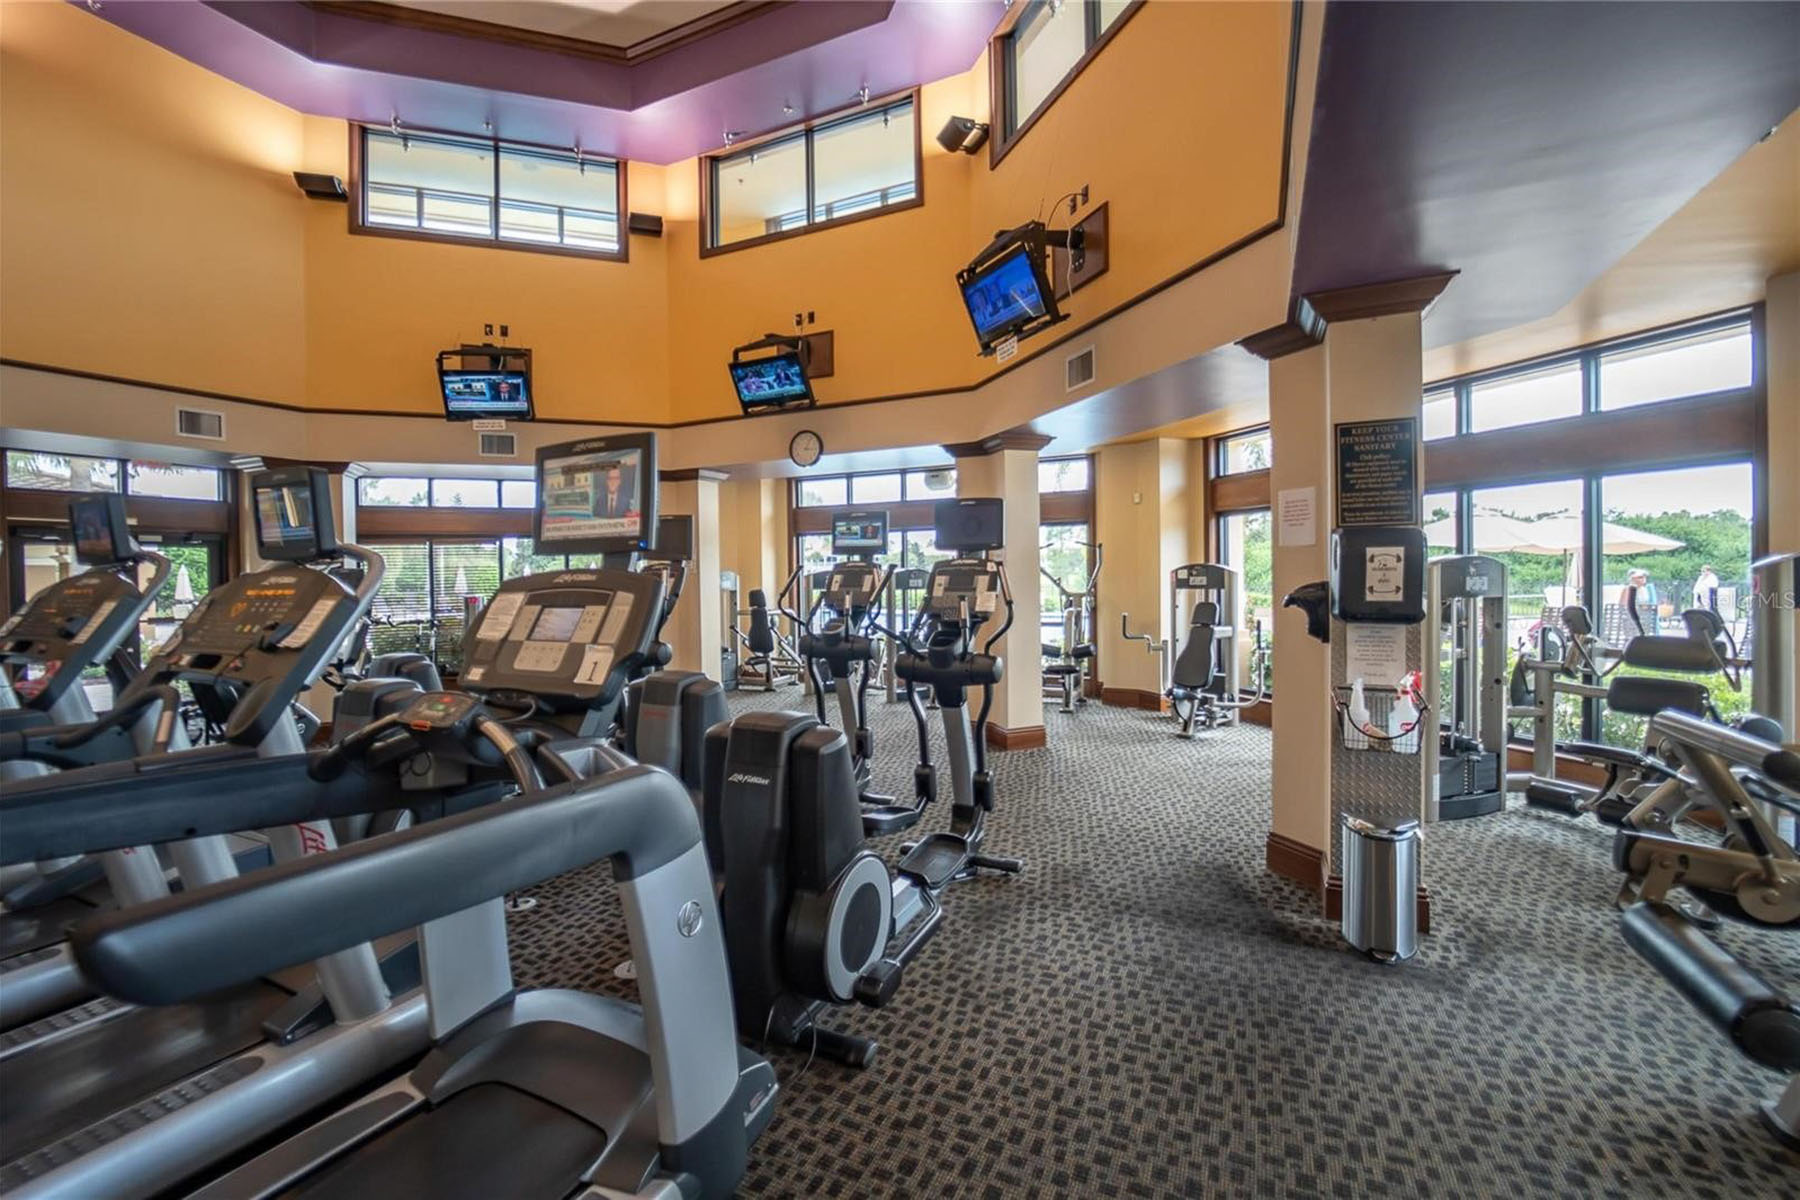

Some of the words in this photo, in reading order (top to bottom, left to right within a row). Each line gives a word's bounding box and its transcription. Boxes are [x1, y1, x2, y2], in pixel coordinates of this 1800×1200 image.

[1351, 427, 1375, 435] KEEP
[1376, 425, 1399, 433] YOUR
[1341, 435, 1376, 444] FITNESS
[1377, 432, 1411, 442] CENTER
[1354, 442, 1396, 451] SANITARY
